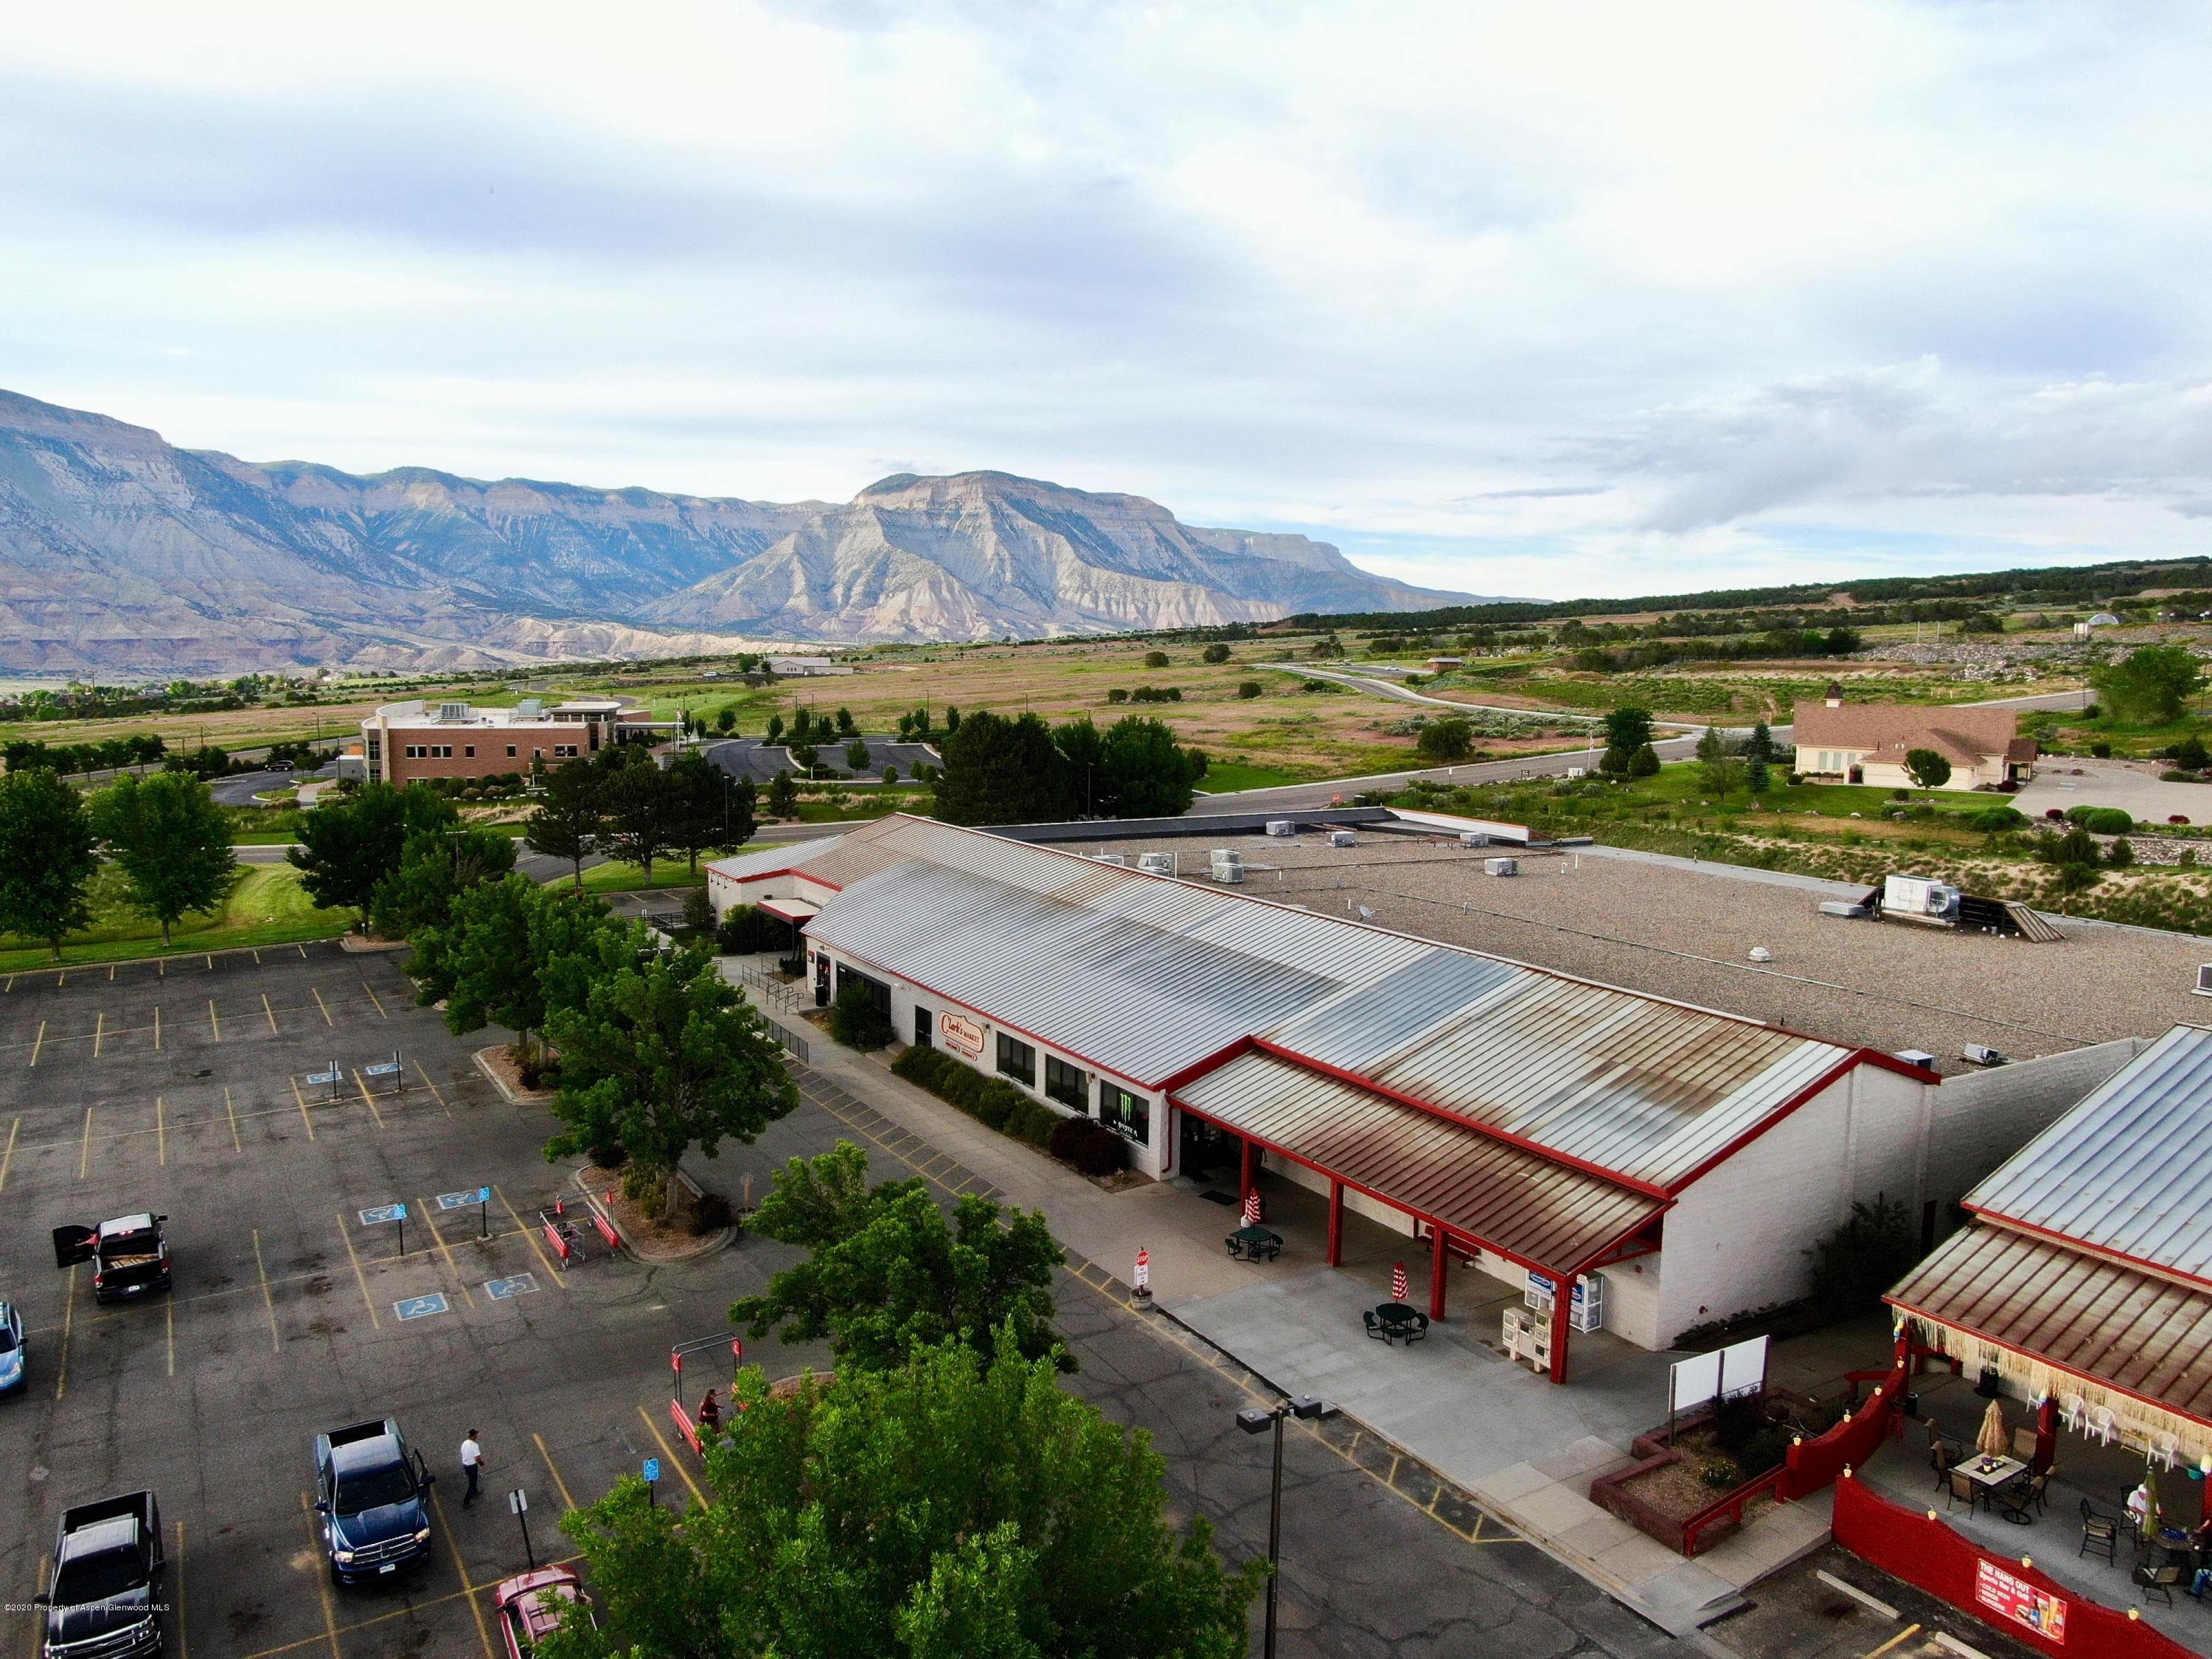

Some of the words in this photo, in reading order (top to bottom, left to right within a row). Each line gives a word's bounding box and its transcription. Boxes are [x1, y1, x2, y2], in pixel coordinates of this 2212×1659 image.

[941, 1015, 963, 1035] Clark's
[963, 1029, 980, 1044] MARKET
[1137, 1254, 1149, 1263] STOP
[1979, 1571, 1998, 1585] Sports
[1999, 1581, 2010, 1592] Bar
[1980, 1561, 1994, 1575] THE
[1994, 1569, 2014, 1586] HANG
[2015, 1580, 2030, 1594] OUT
[1981, 1583, 1997, 1594] COLD
